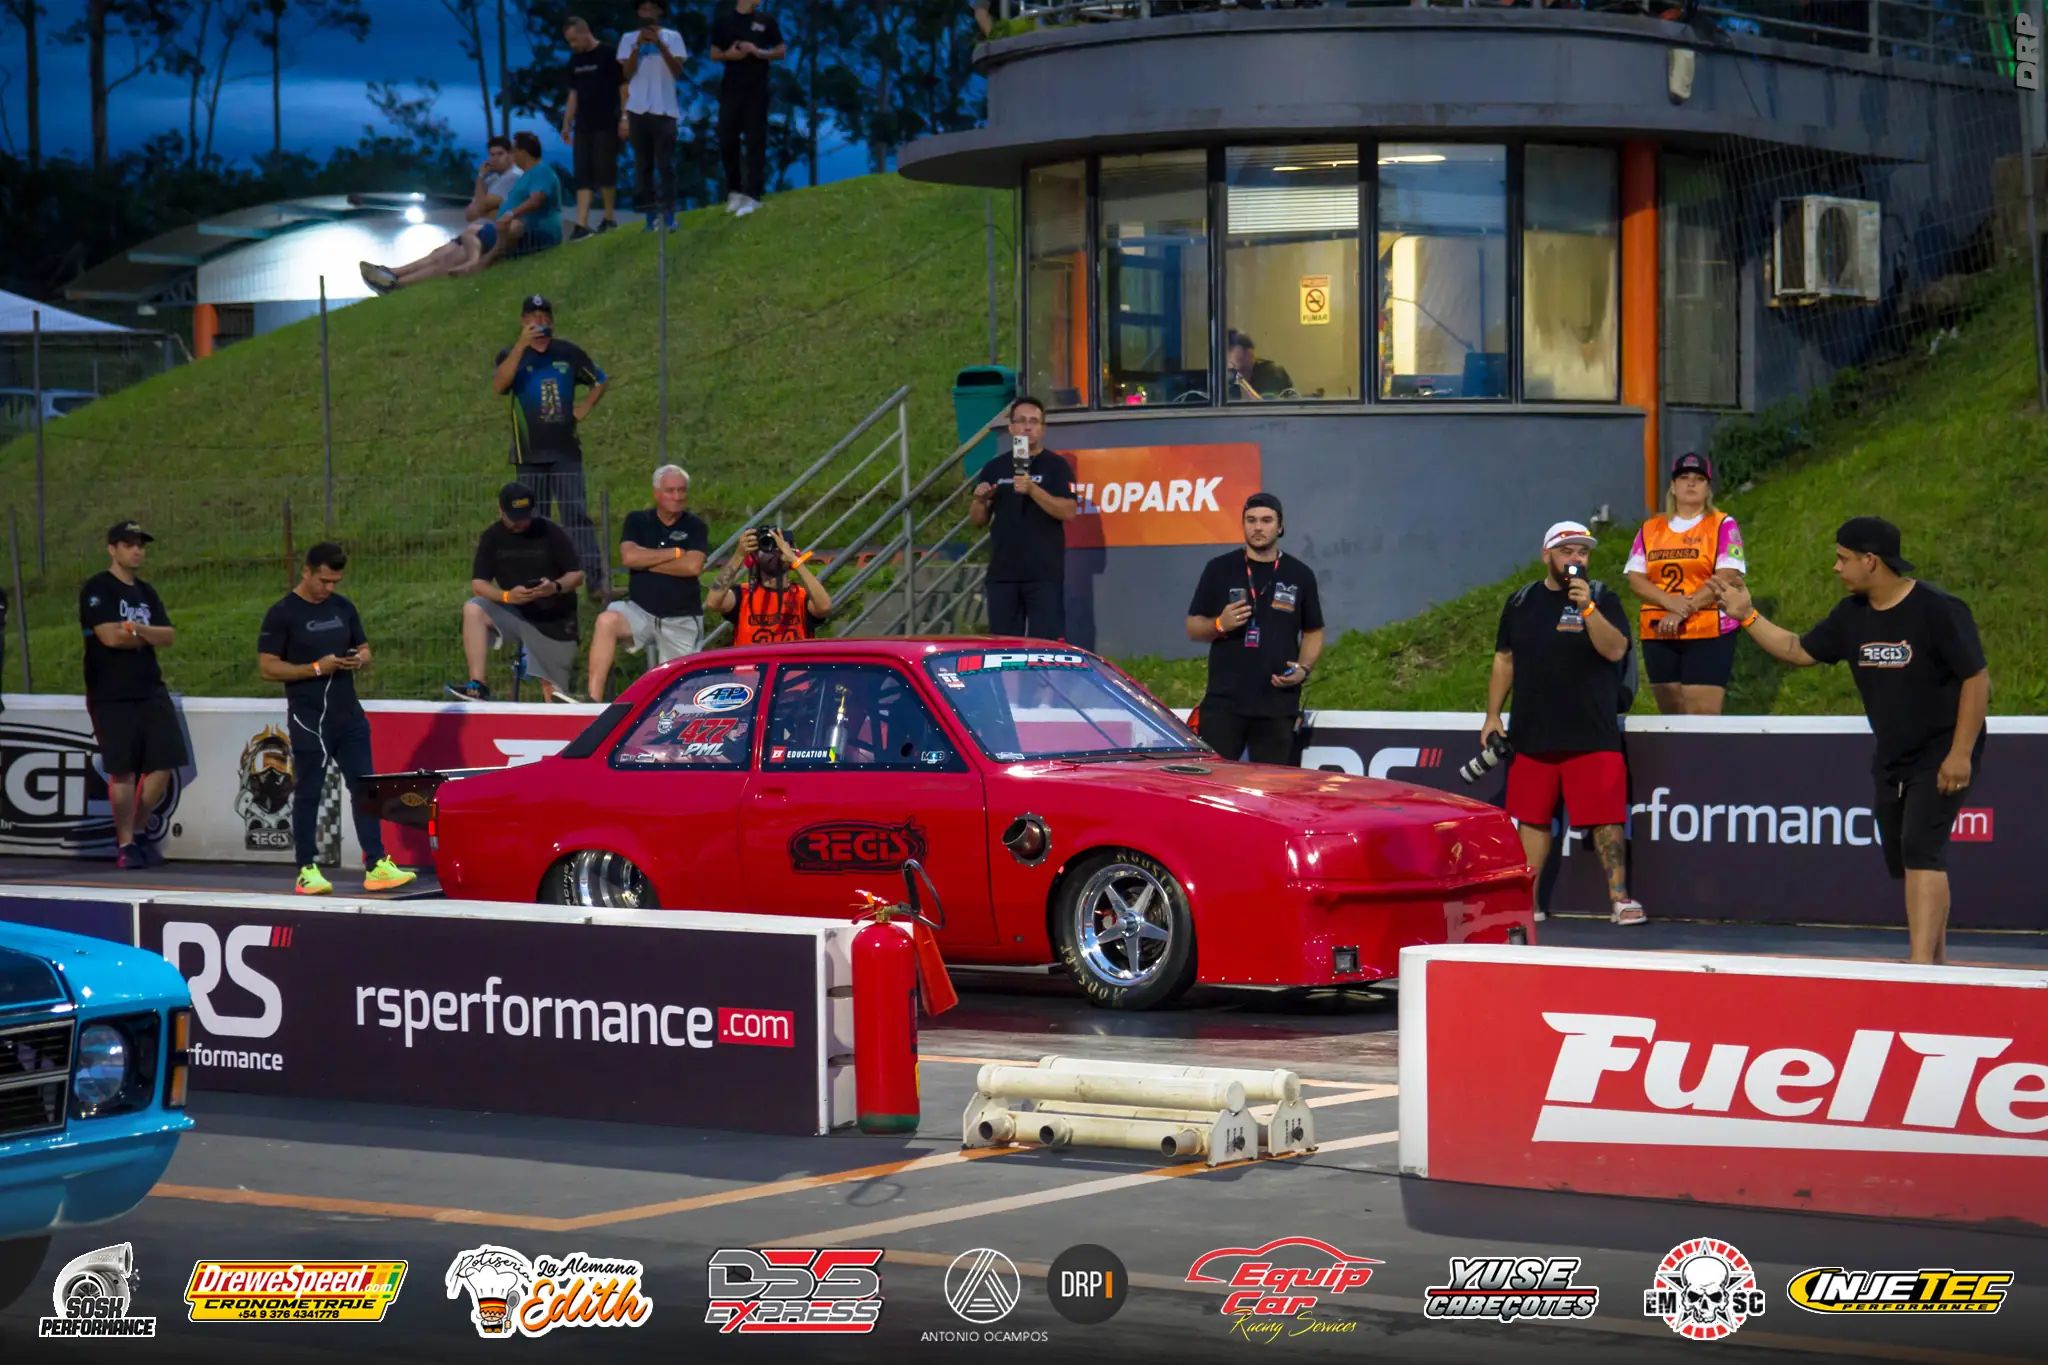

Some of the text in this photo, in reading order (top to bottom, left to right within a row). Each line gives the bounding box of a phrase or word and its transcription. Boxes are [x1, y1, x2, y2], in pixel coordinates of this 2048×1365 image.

[1067, 476, 1223, 516] ELOPARK
[1661, 563, 1685, 595] 2
[677, 718, 738, 744] 477
[682, 743, 724, 757] PML
[786, 750, 828, 759] EDUCATION
